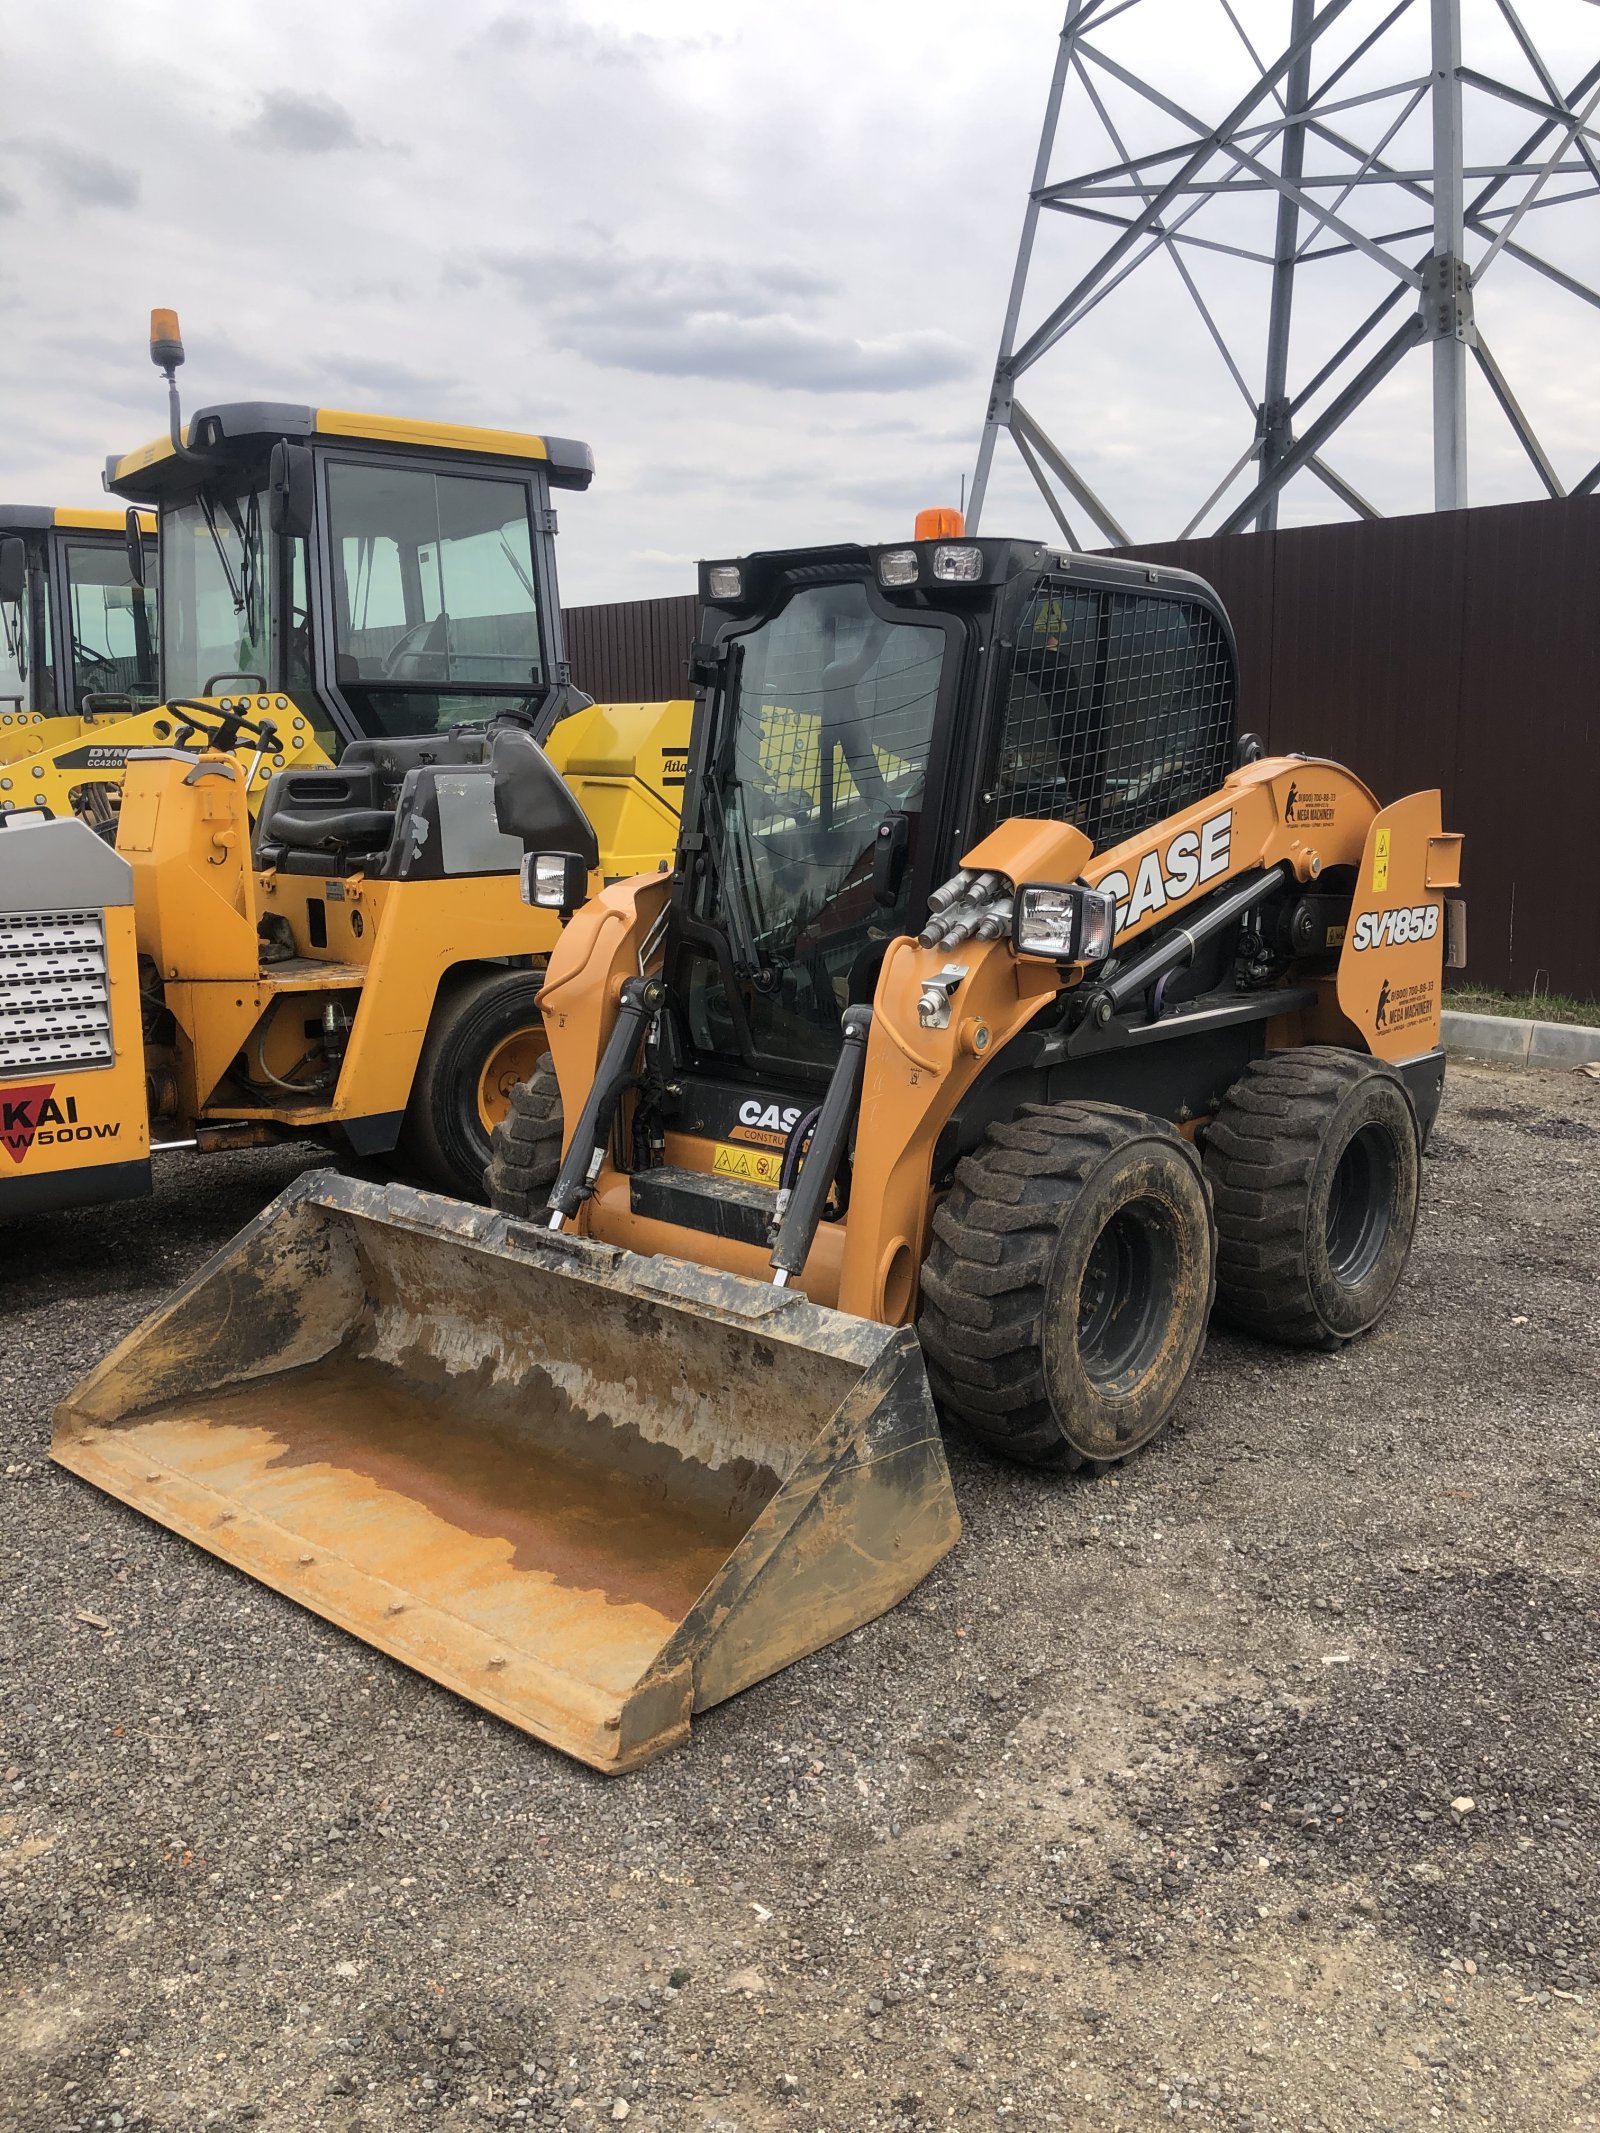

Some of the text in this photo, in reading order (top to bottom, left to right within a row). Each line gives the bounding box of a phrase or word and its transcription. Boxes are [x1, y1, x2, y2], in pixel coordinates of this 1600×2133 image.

[89, 748, 128, 757] DYN
[87, 759, 122, 767] CC4200
[662, 760, 688, 772] Atla
[1297, 809, 1310, 821] MEGA
[1095, 807, 1233, 936] CASE
[1353, 904, 1440, 952] SV185B
[1389, 1007, 1404, 1024] MEGA
[2, 1096, 78, 1131] KAI
[739, 1101, 817, 1136] CAS
[744, 1129, 786, 1146] CONSTRU
